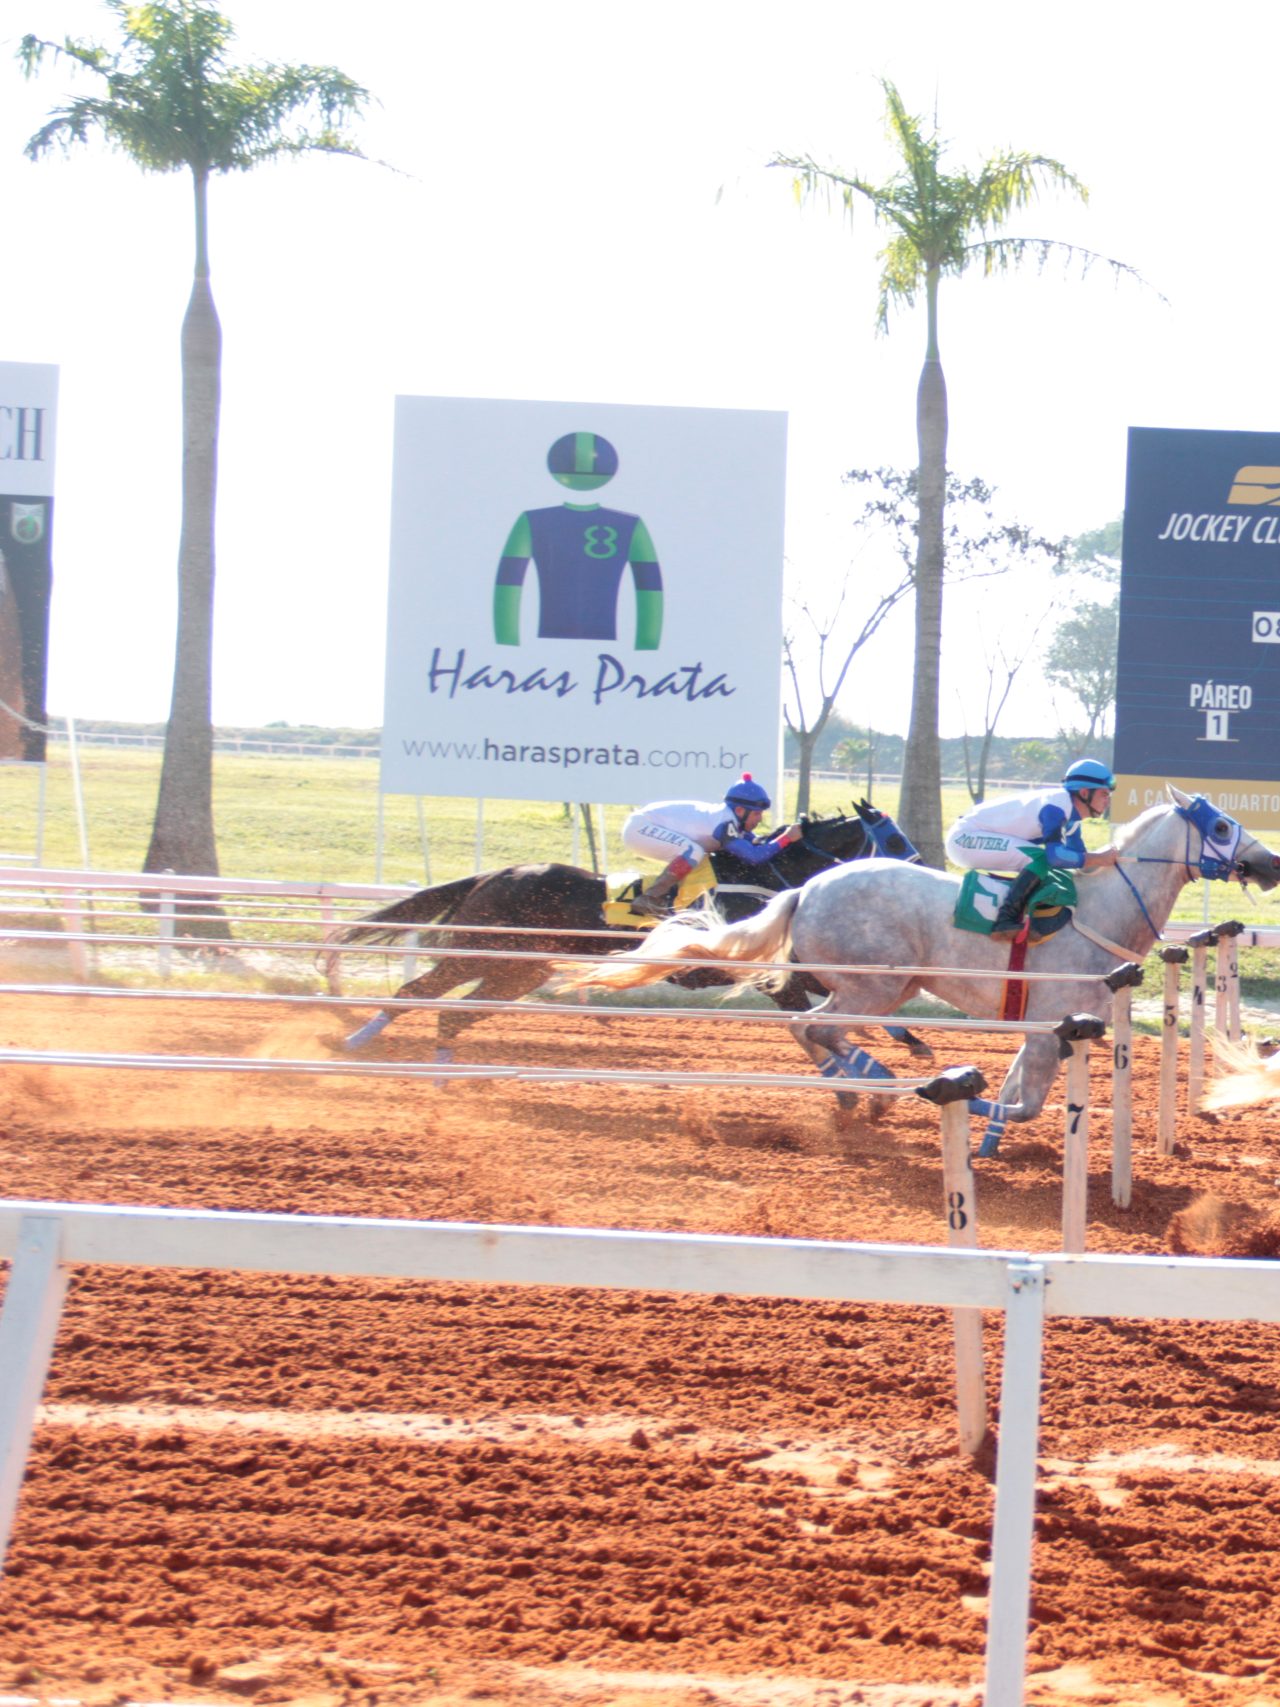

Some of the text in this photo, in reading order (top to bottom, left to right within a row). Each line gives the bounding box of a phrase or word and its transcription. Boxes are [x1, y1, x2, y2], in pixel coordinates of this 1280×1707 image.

[1158, 512, 1252, 543] JOCKEY
[427, 646, 736, 705] Haras Prata
[1190, 679, 1252, 710] PÁREO
[1212, 714, 1222, 736] 1
[402, 738, 750, 770] www.harasprata.com.br
[1218, 792, 1280, 812] QUARTO
[1193, 984, 1203, 1006] 4
[1217, 975, 1227, 993] 3
[1163, 1004, 1177, 1028] 5
[1114, 1043, 1129, 1071] 6
[1067, 1103, 1084, 1135] 7
[948, 1191, 968, 1231] 8
